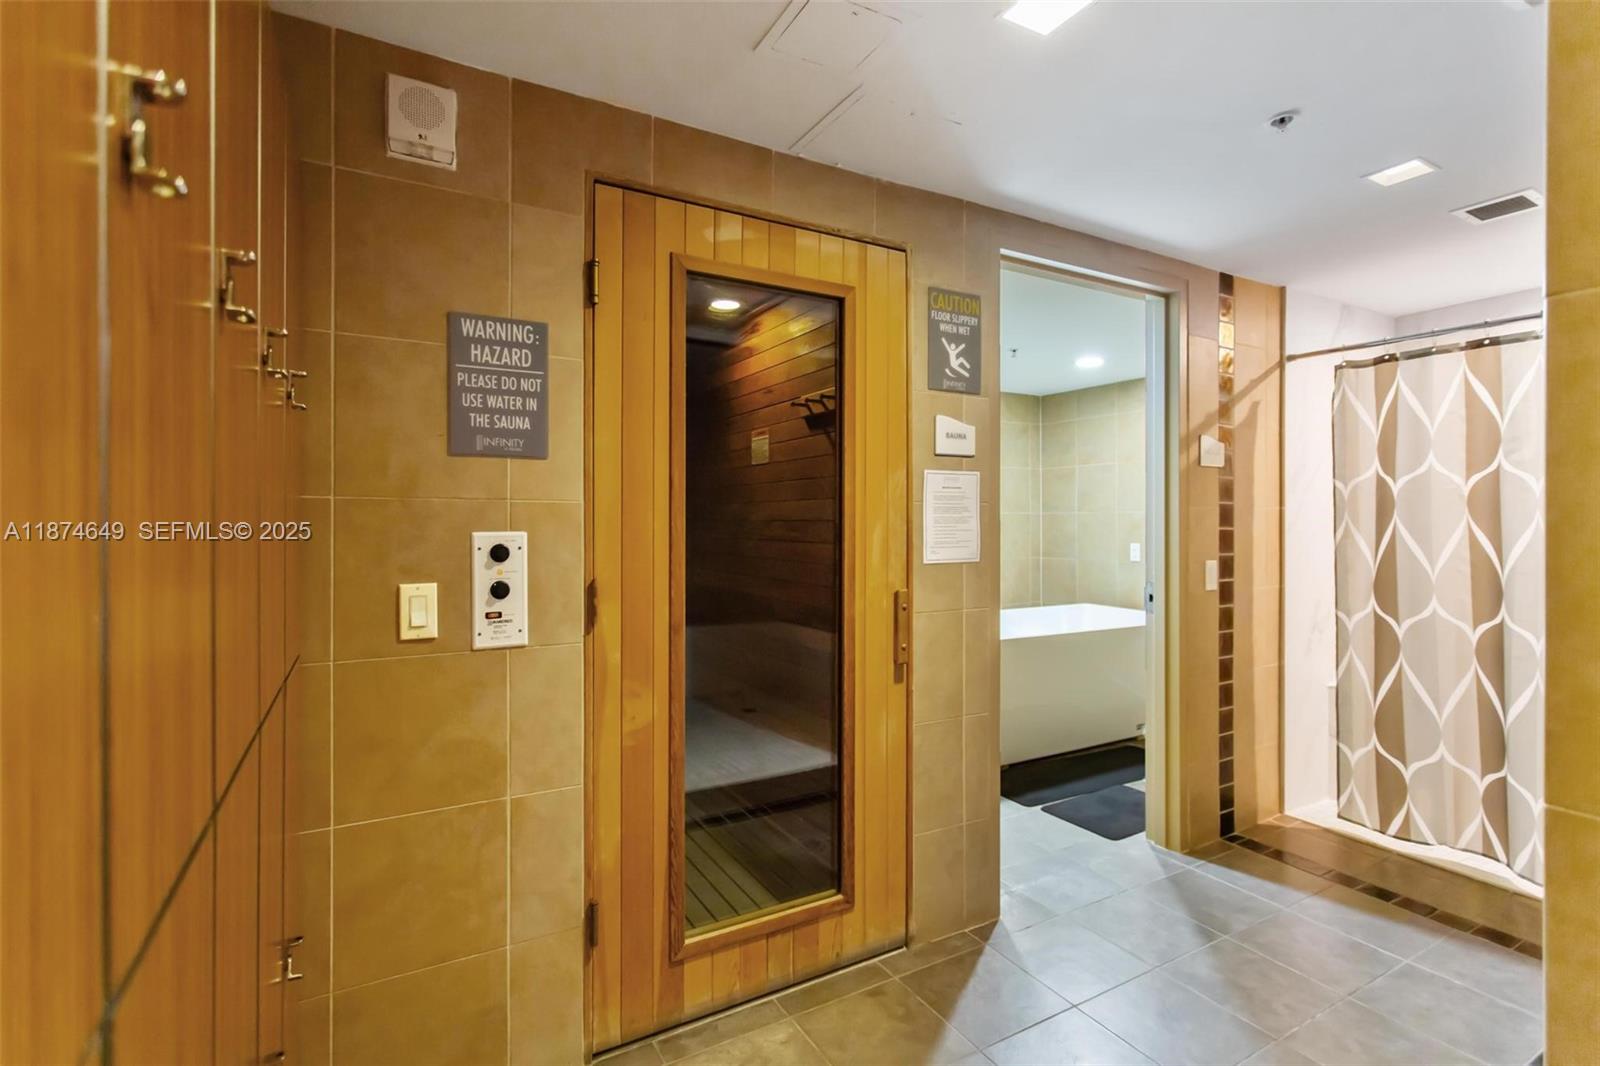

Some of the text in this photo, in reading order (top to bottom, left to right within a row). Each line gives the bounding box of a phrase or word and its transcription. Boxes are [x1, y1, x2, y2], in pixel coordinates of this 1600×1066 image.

[930, 292, 979, 315] CAUTION
[931, 310, 979, 326] FLOOR SLIPPERY
[461, 317, 540, 345] WARNING:
[939, 322, 970, 336] WHEN WET
[471, 343, 532, 368] HAZARD
[457, 372, 542, 393] PLEASE DO NOT
[462, 393, 537, 411] USE WATER IN
[469, 413, 531, 430] THE SAUNA
[484, 437, 524, 448] INFINITY
[945, 431, 967, 440] SAUNA
